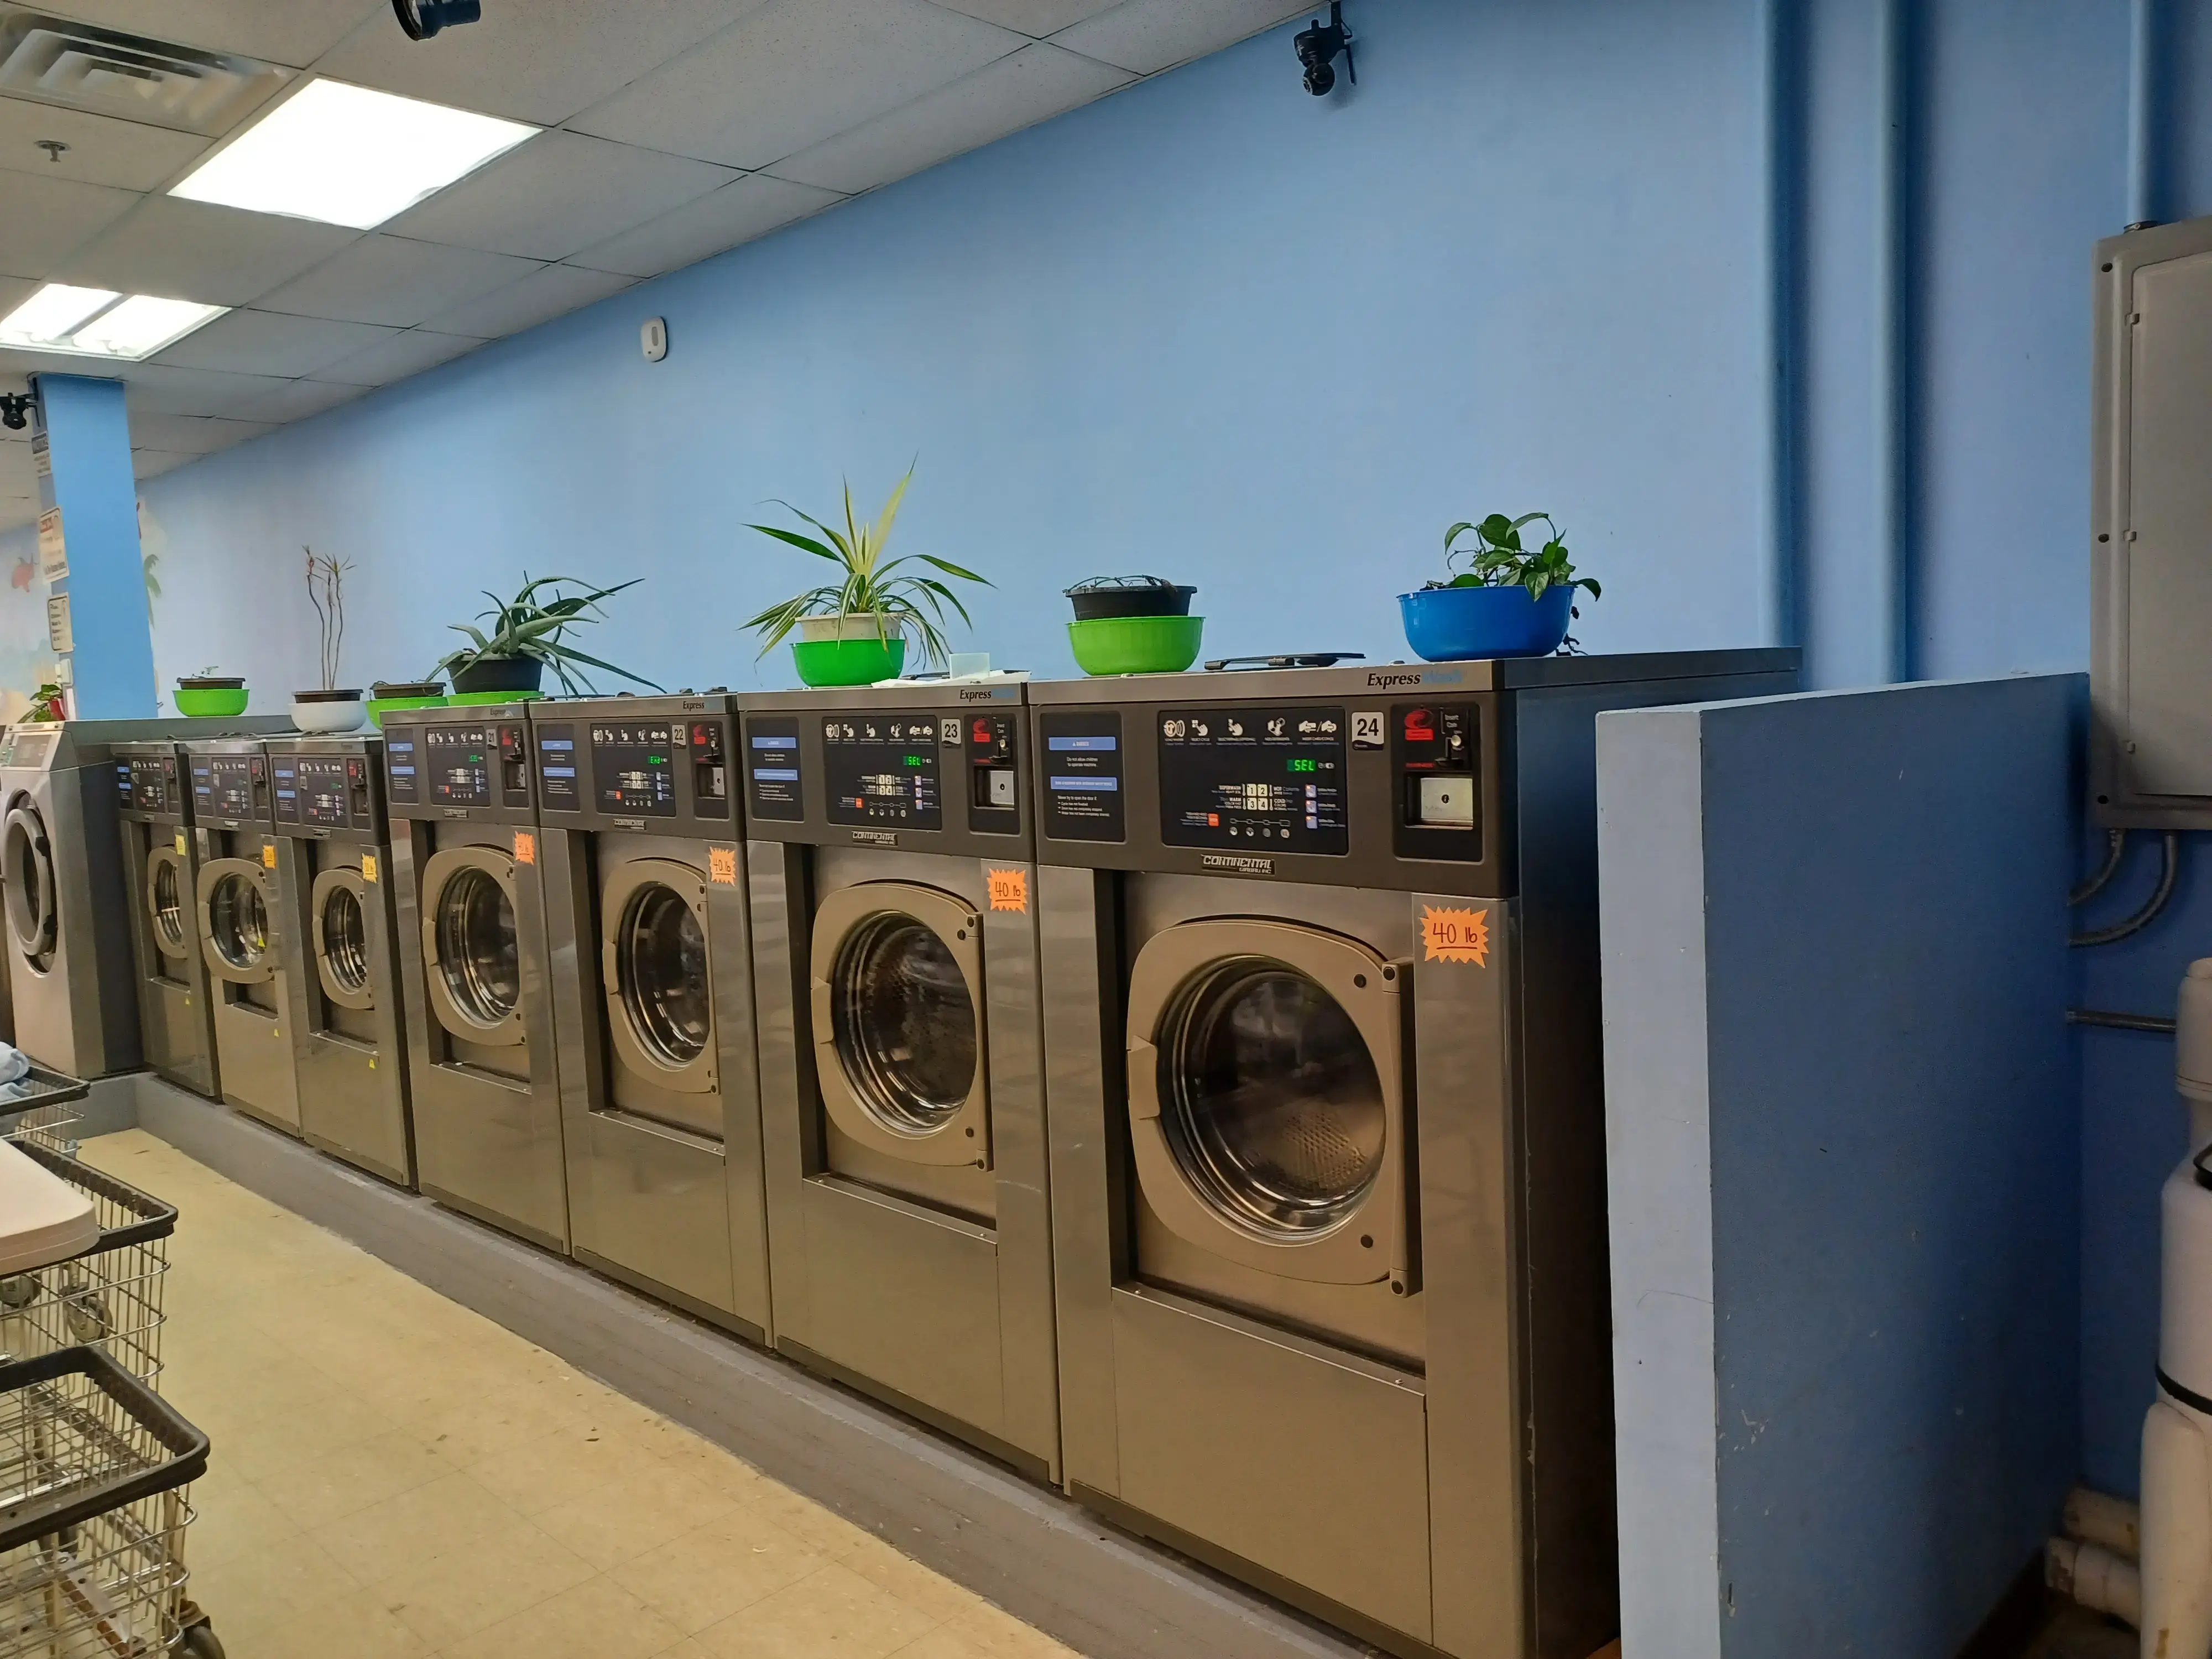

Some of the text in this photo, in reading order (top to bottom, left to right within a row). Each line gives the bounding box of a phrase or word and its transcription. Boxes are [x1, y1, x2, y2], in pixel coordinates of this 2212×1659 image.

[1367, 673, 1421, 690] Express
[959, 689, 992, 702] Express
[945, 724, 957, 738] 23
[1357, 718, 1379, 736] 24
[675, 729, 684, 740] 22
[909, 757, 920, 765] SEL
[1295, 759, 1314, 771] SEL
[713, 858, 723, 871] 40
[1203, 855, 1272, 869] CONTINENTAL
[995, 881, 1021, 896] 40 lb
[1433, 923, 1478, 943] 40 lb
